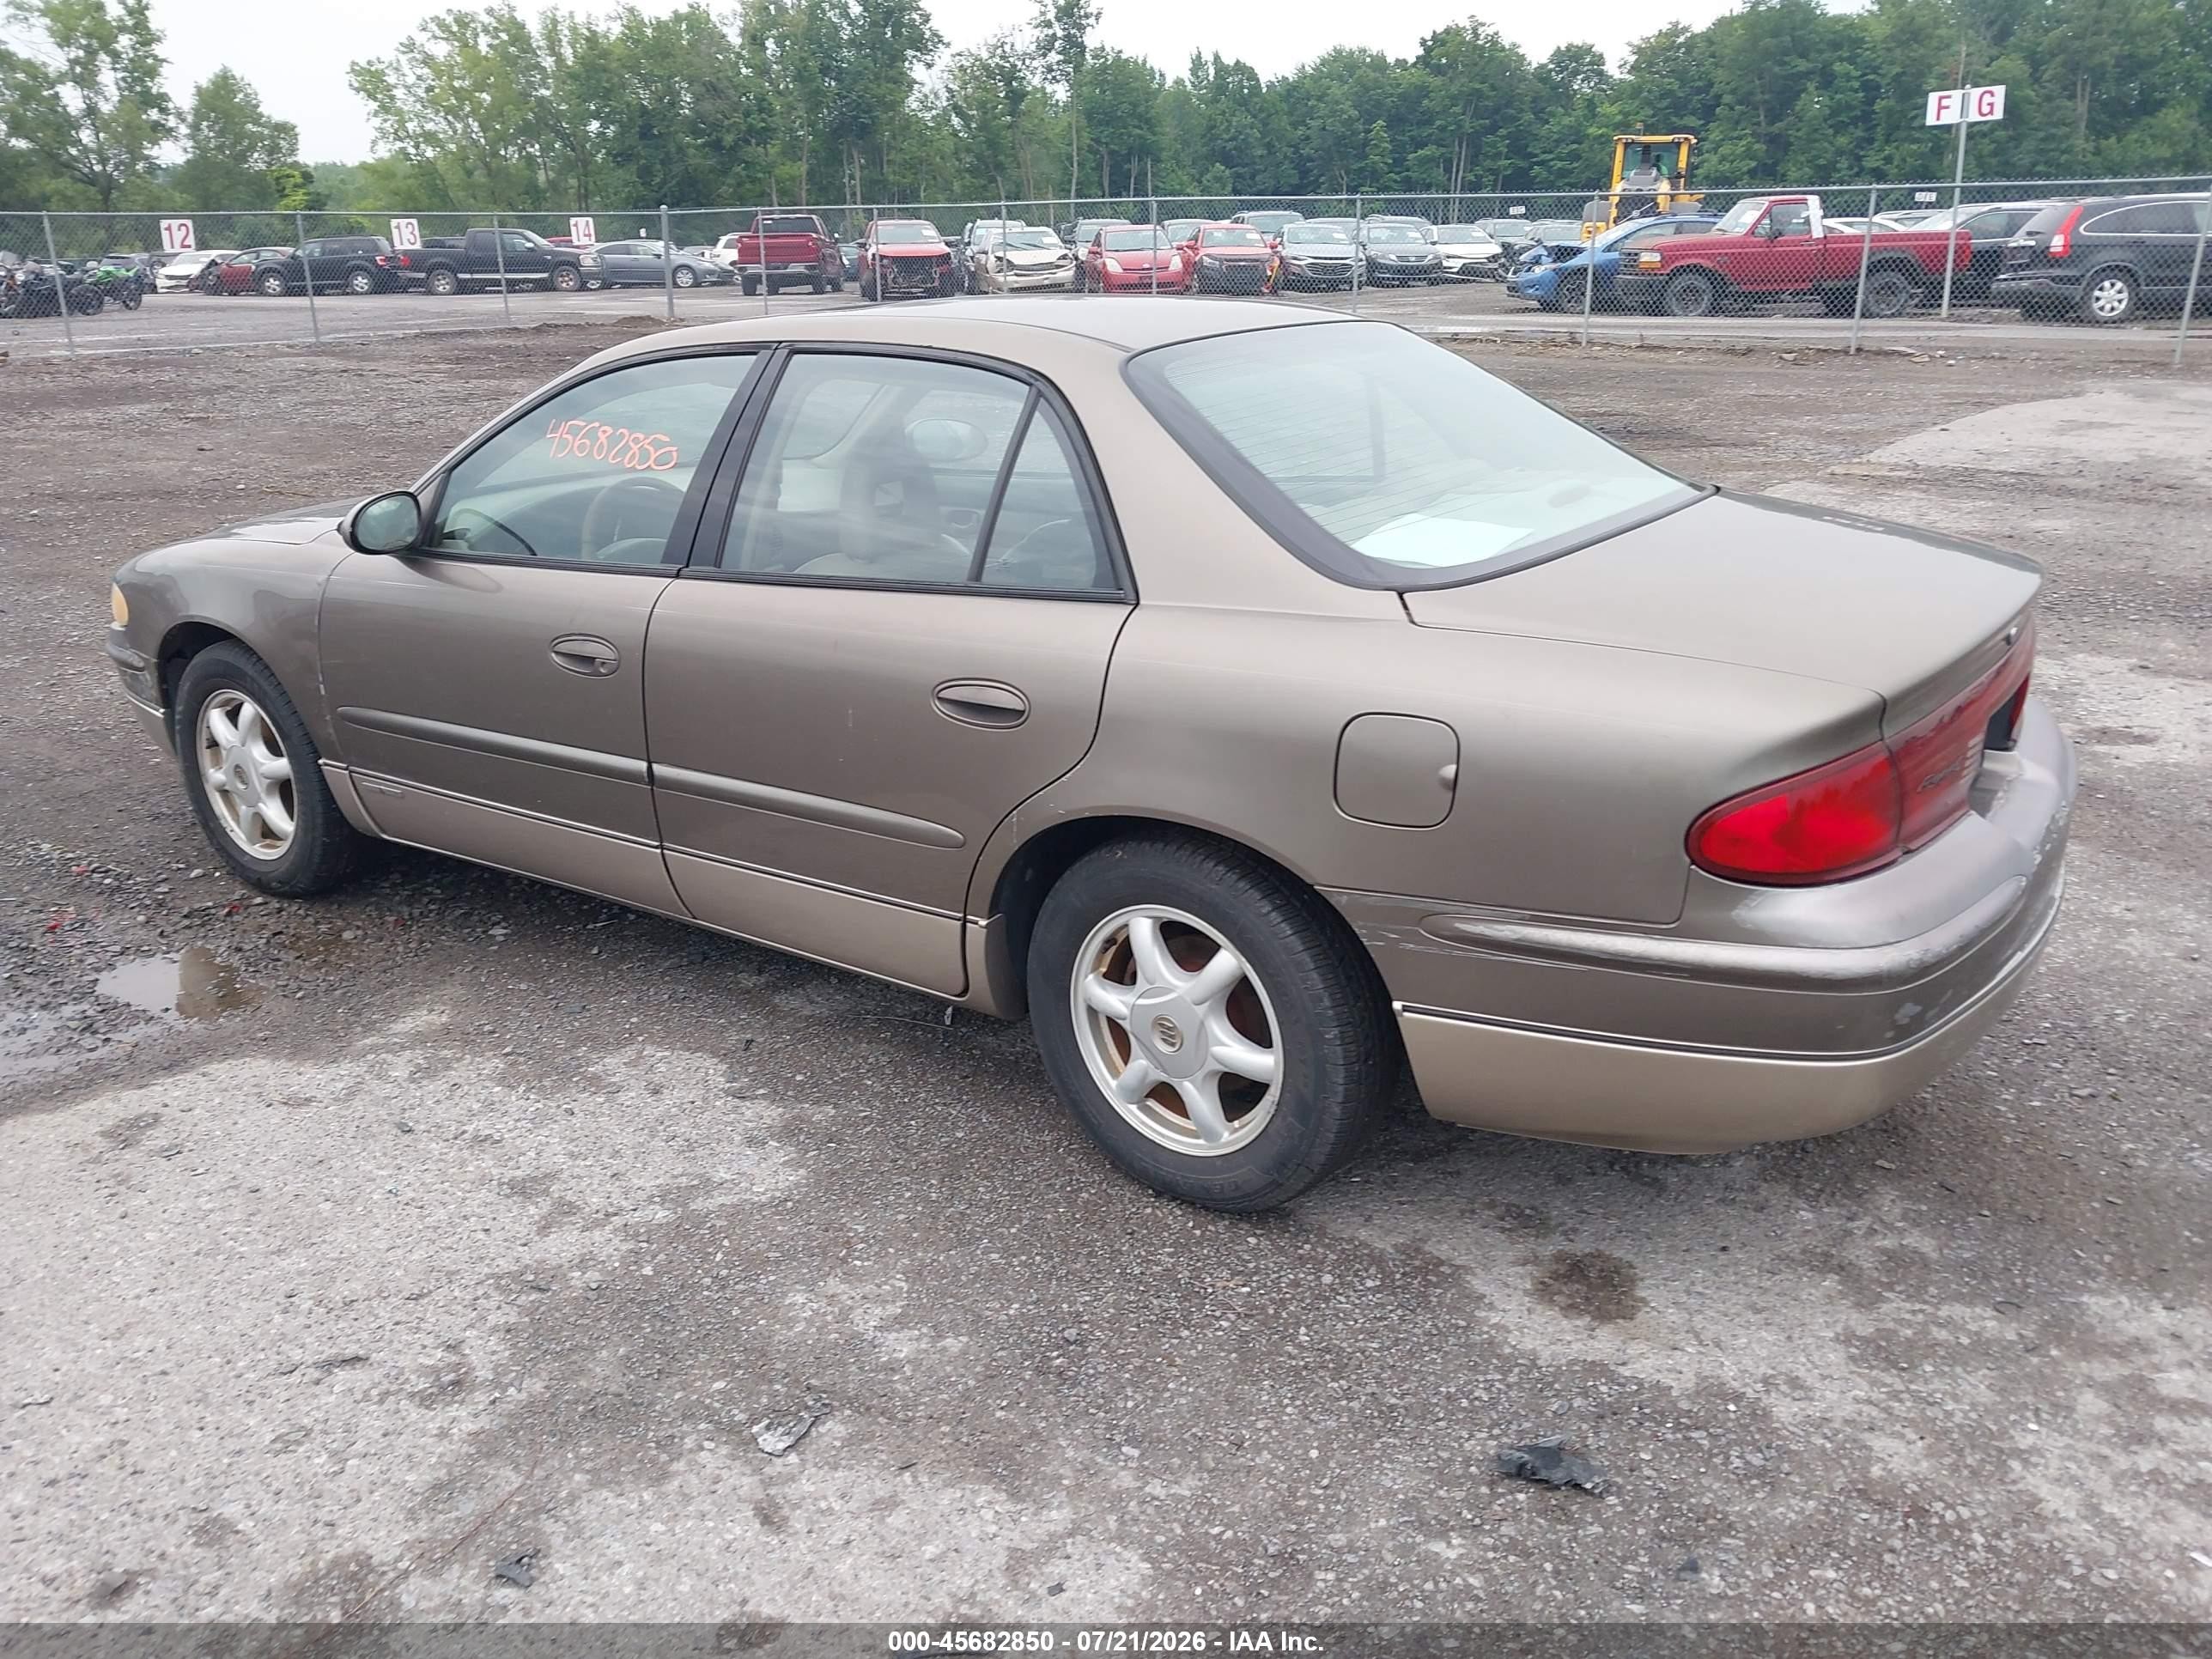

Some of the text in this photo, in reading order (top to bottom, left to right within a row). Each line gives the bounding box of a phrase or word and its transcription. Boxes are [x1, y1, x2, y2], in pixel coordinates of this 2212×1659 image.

[1936, 89, 1996, 121] F G
[163, 222, 192, 249] 12
[393, 222, 417, 246] 13
[572, 220, 592, 242] 14
[545, 418, 680, 471] 45682850
